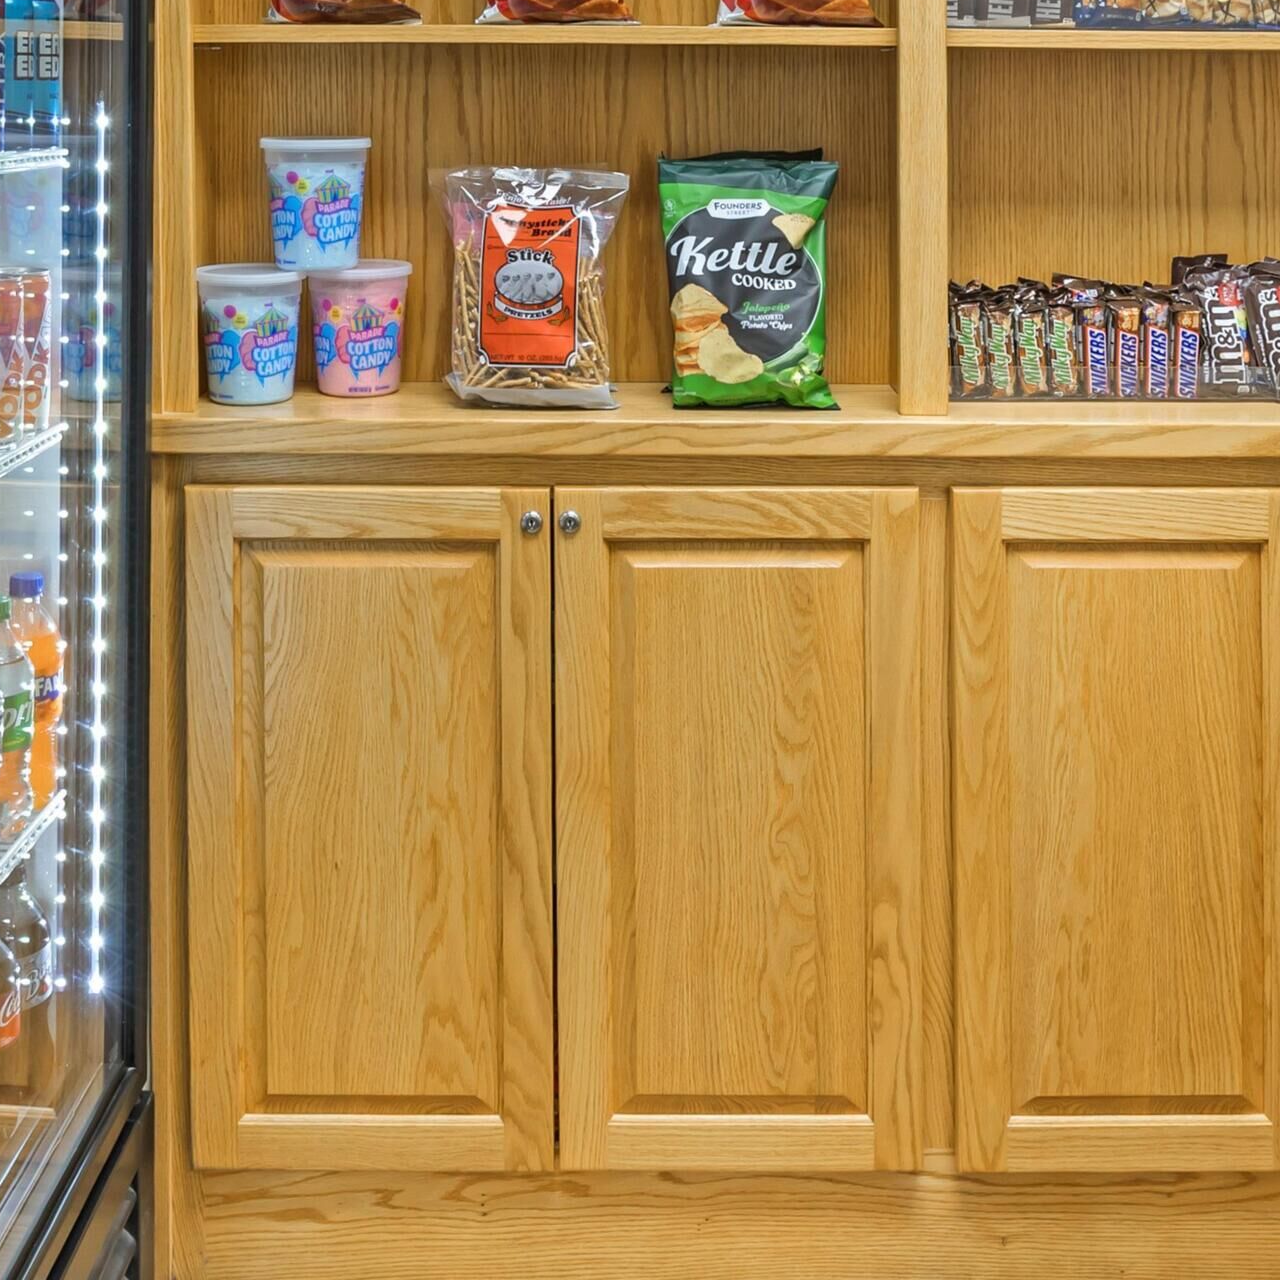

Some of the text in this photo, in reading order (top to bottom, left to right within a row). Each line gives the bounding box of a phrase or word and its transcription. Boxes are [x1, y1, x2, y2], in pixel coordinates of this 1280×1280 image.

[317, 198, 350, 213] PARADE
[713, 200, 763, 211] FOUNDERS
[315, 210, 357, 227] COTTON
[319, 223, 356, 243] CANDY
[507, 248, 554, 265] Stick
[670, 235, 798, 276] Kettle
[731, 272, 797, 292] COOKED
[503, 306, 553, 319] PRETZELS
[252, 342, 294, 361] COTTON
[256, 355, 293, 375] CANDY
[1089, 327, 1108, 397] SNICKERS
[1120, 331, 1138, 398] SNICKERS
[1151, 327, 1168, 398] SNICKERS
